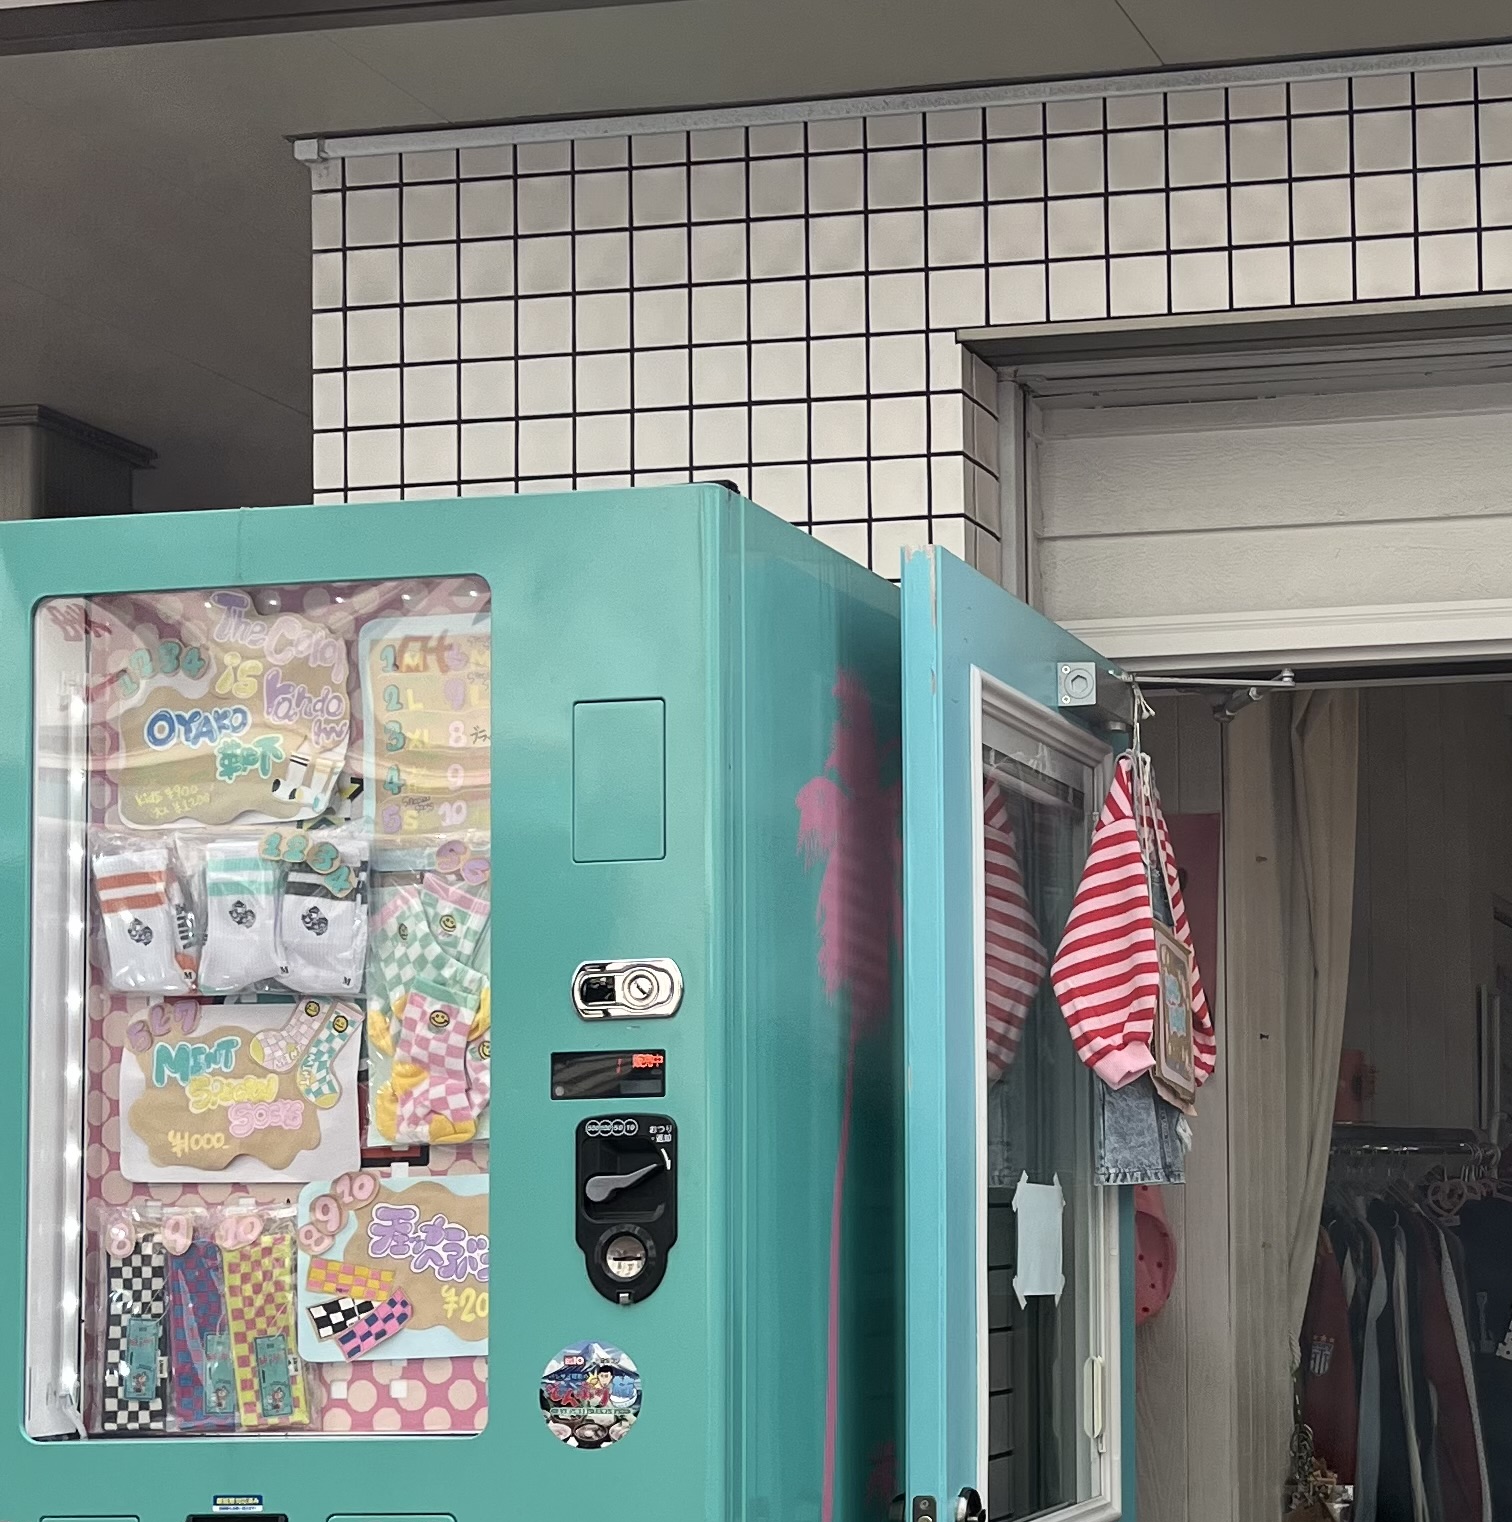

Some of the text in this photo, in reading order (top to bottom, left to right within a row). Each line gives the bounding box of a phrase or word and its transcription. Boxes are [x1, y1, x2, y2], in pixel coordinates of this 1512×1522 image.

[211, 591, 268, 648] The
[215, 651, 263, 699] is
[383, 684, 404, 712] 2
[144, 705, 252, 750] OYAKO
[383, 720, 406, 752] 3
[448, 720, 467, 748] 8
[382, 763, 406, 796] 4
[447, 763, 465, 791] 9
[439, 799, 468, 827] 10
[183, 970, 193, 981] M
[280, 965, 289, 975] M
[336, 1172, 375, 1204] 10
[314, 1196, 341, 1232] 9
[110, 1223, 131, 1254] 8
[165, 1215, 188, 1254] 9
[217, 1215, 262, 1247] 10
[299, 1224, 330, 1253] 8
